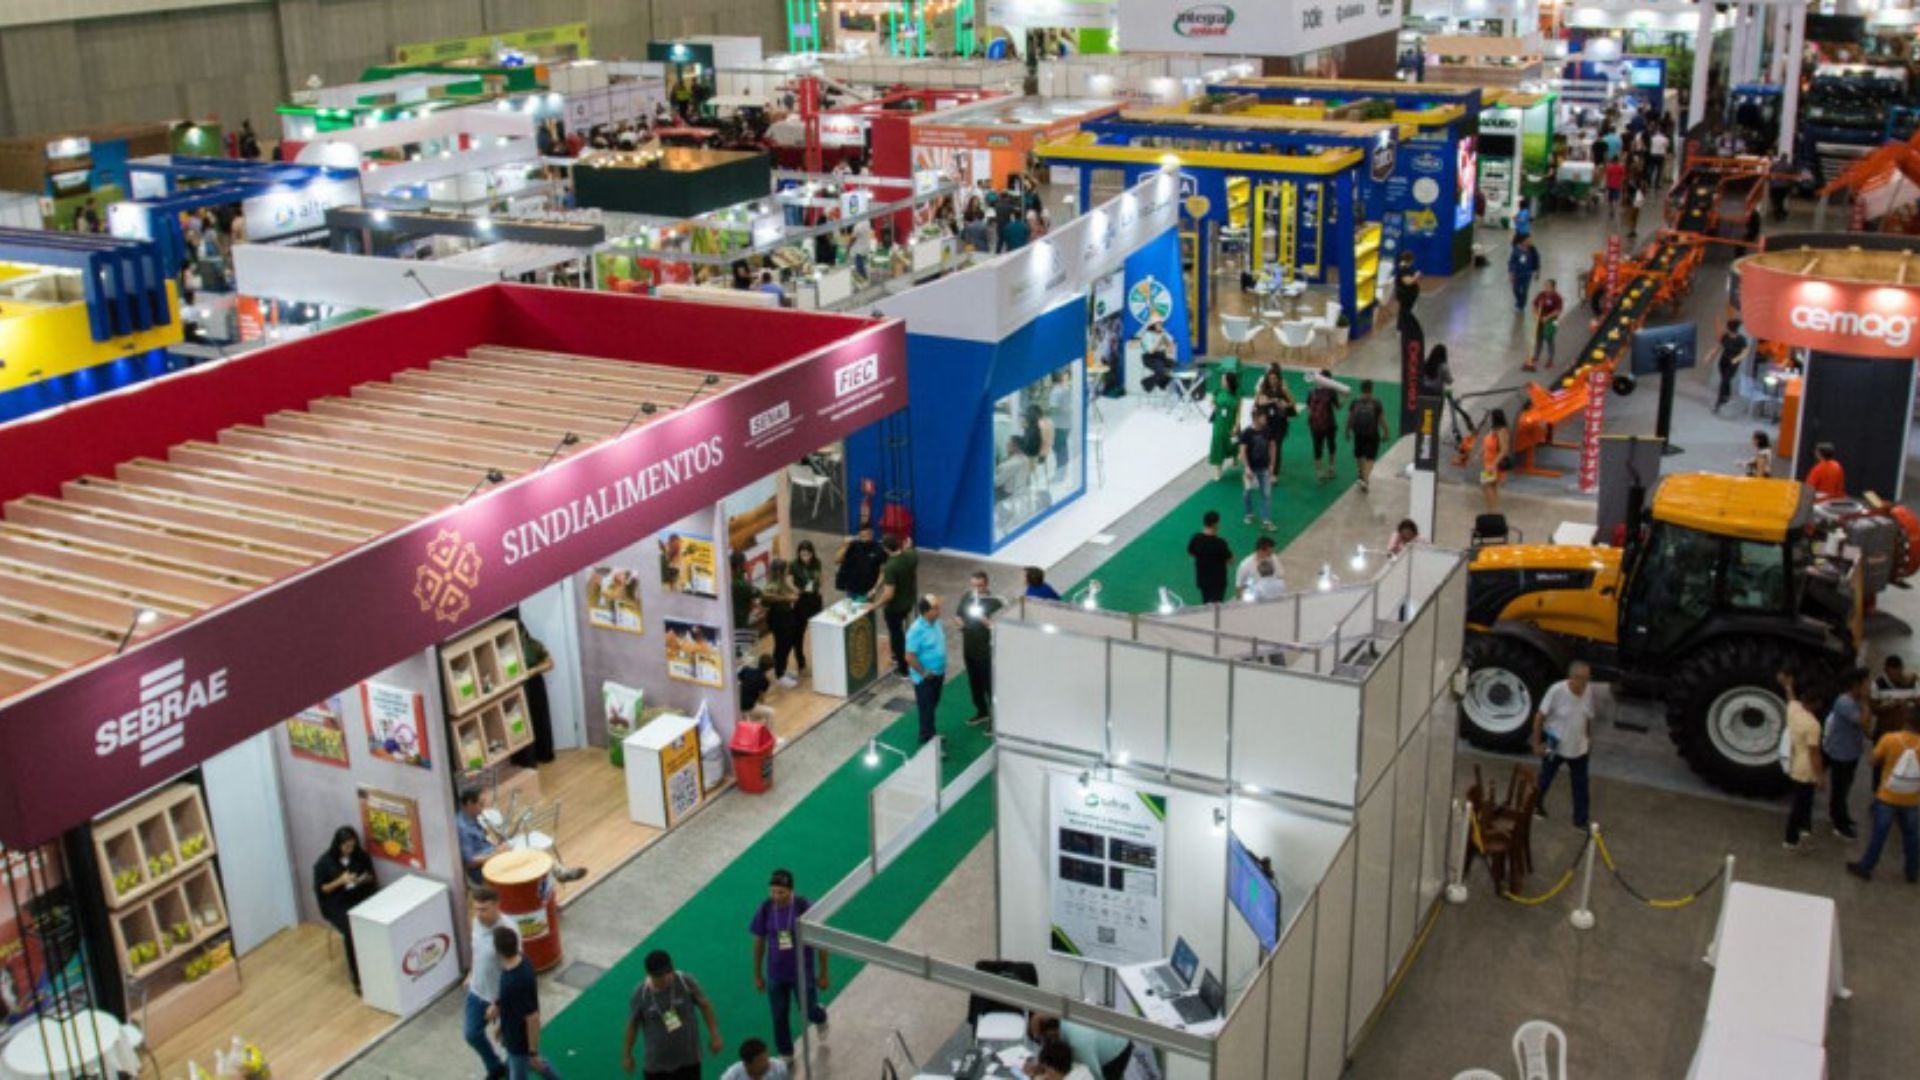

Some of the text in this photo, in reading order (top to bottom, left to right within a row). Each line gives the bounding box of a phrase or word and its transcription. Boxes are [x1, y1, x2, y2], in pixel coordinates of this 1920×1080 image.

[837, 359, 874, 393] FIEC
[502, 436, 724, 566] SINDIALIMENTOS
[95, 667, 227, 756] SEBRAE
